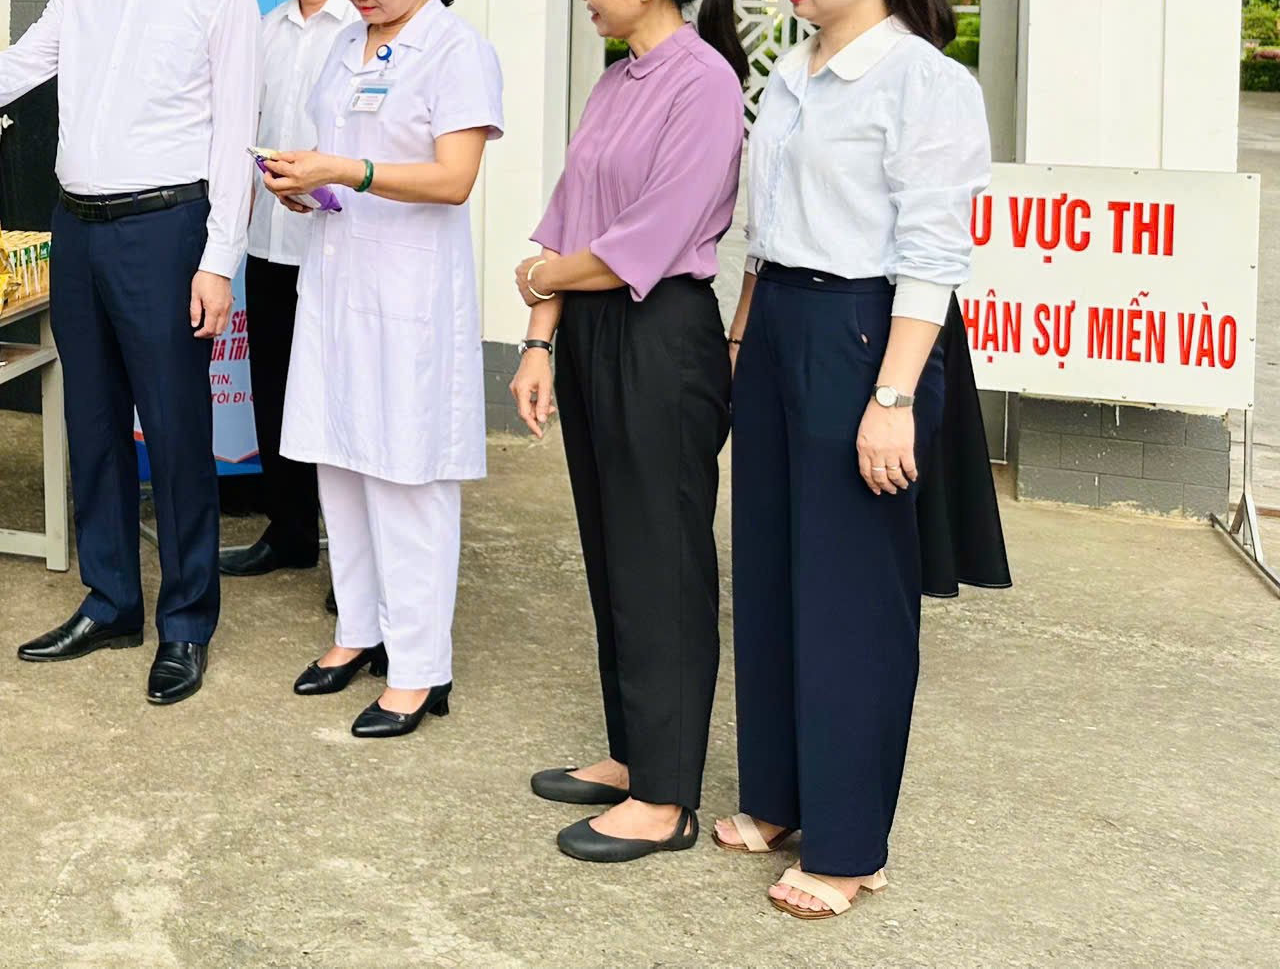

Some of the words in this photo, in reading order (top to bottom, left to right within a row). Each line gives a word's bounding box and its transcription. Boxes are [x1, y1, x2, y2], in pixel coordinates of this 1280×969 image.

[1008, 193, 1091, 264] VỰC
[1108, 201, 1175, 257] THI
[963, 288, 1022, 363] HẬN
[1032, 300, 1076, 369] SỰ
[1087, 291, 1167, 365] MIỄN
[1177, 301, 1238, 370] VÀO
